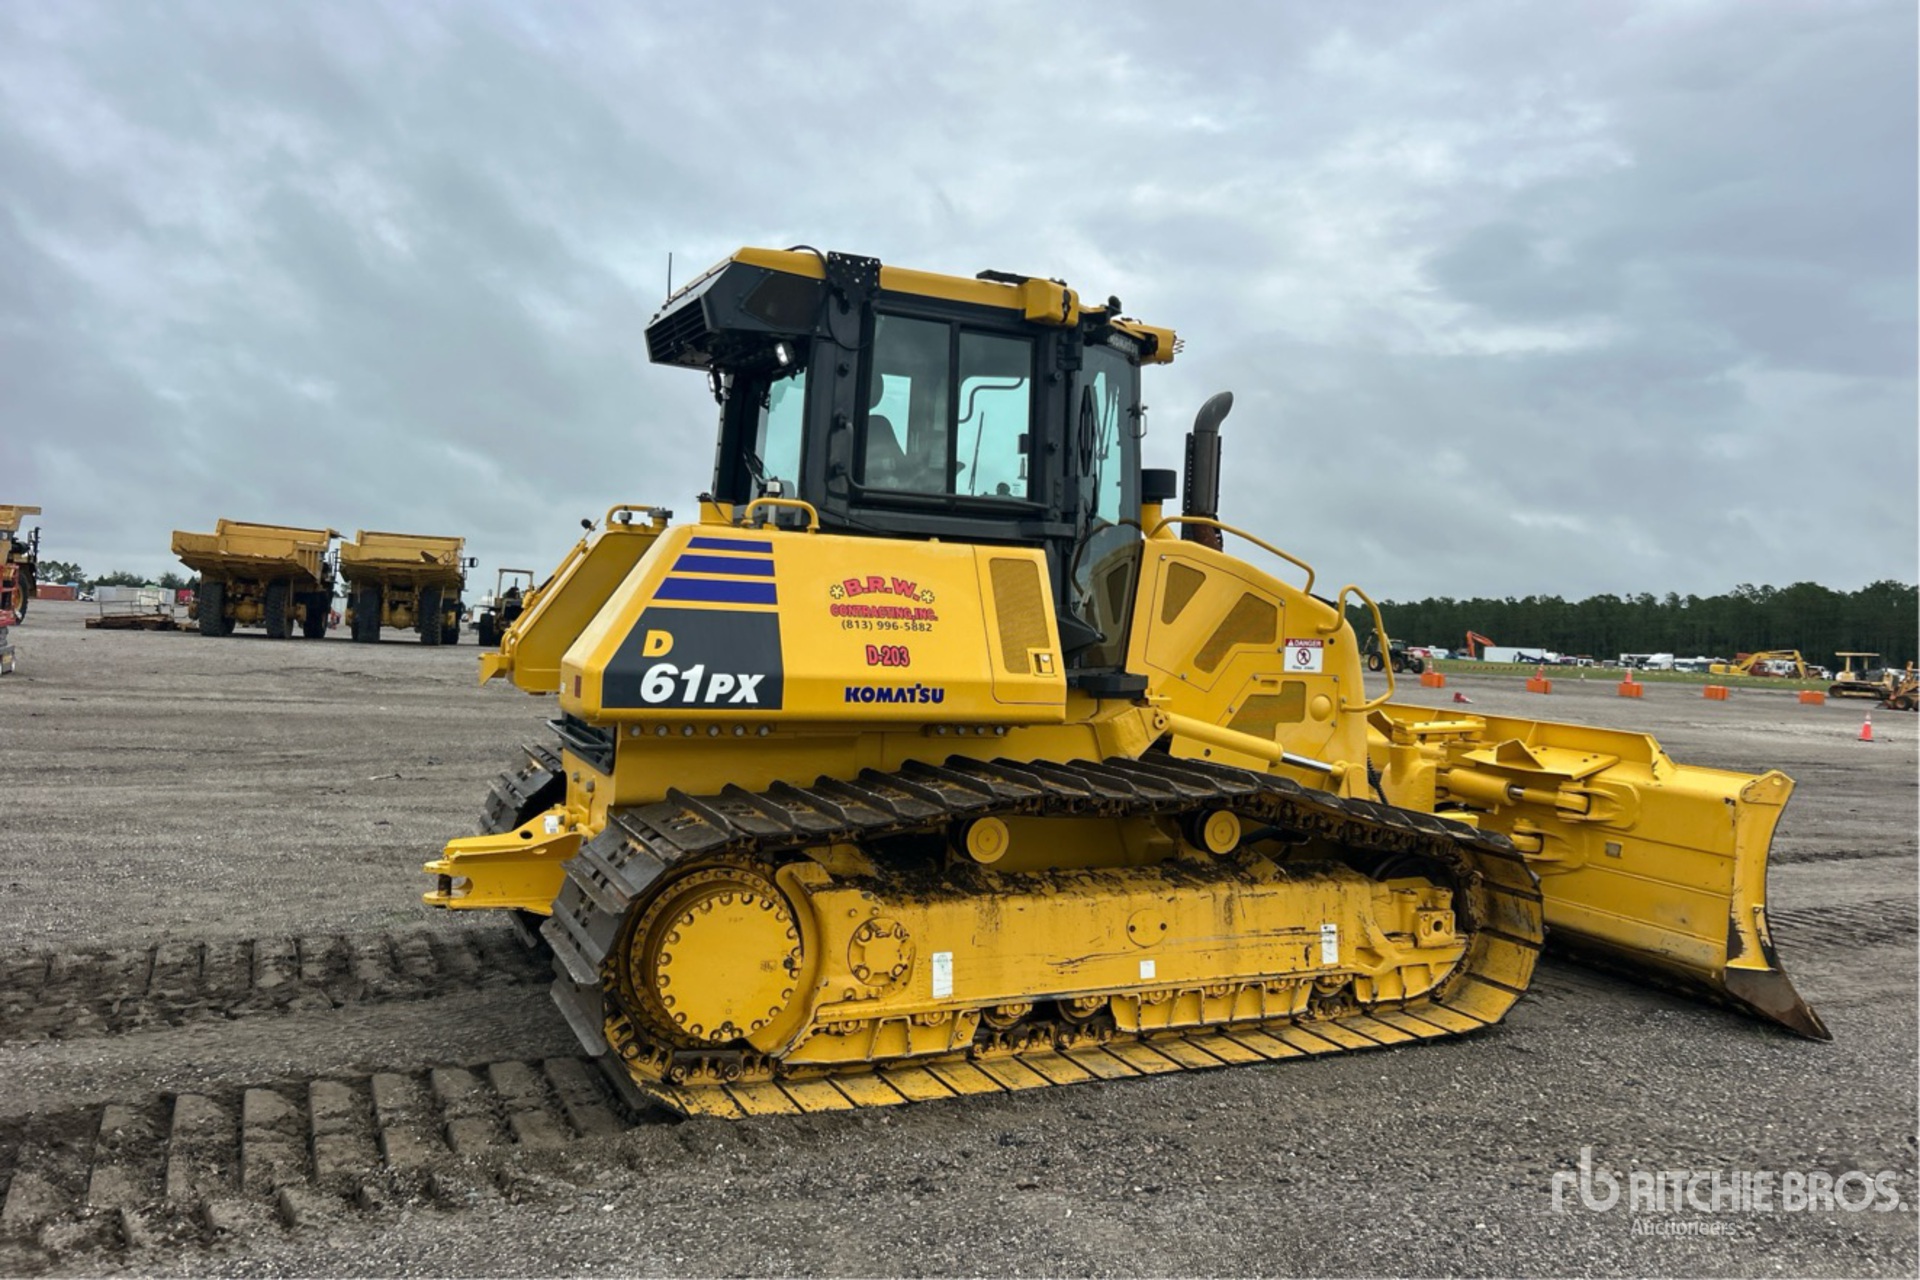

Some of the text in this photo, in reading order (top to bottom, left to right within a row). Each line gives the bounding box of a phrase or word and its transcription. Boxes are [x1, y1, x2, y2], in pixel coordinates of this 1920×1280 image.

[843, 576, 921, 602] B.R.W.
[841, 619, 933, 632] (813) 996-5882
[642, 629, 674, 657] D
[866, 645, 910, 667] D-203
[845, 683, 944, 703] KOMATSU
